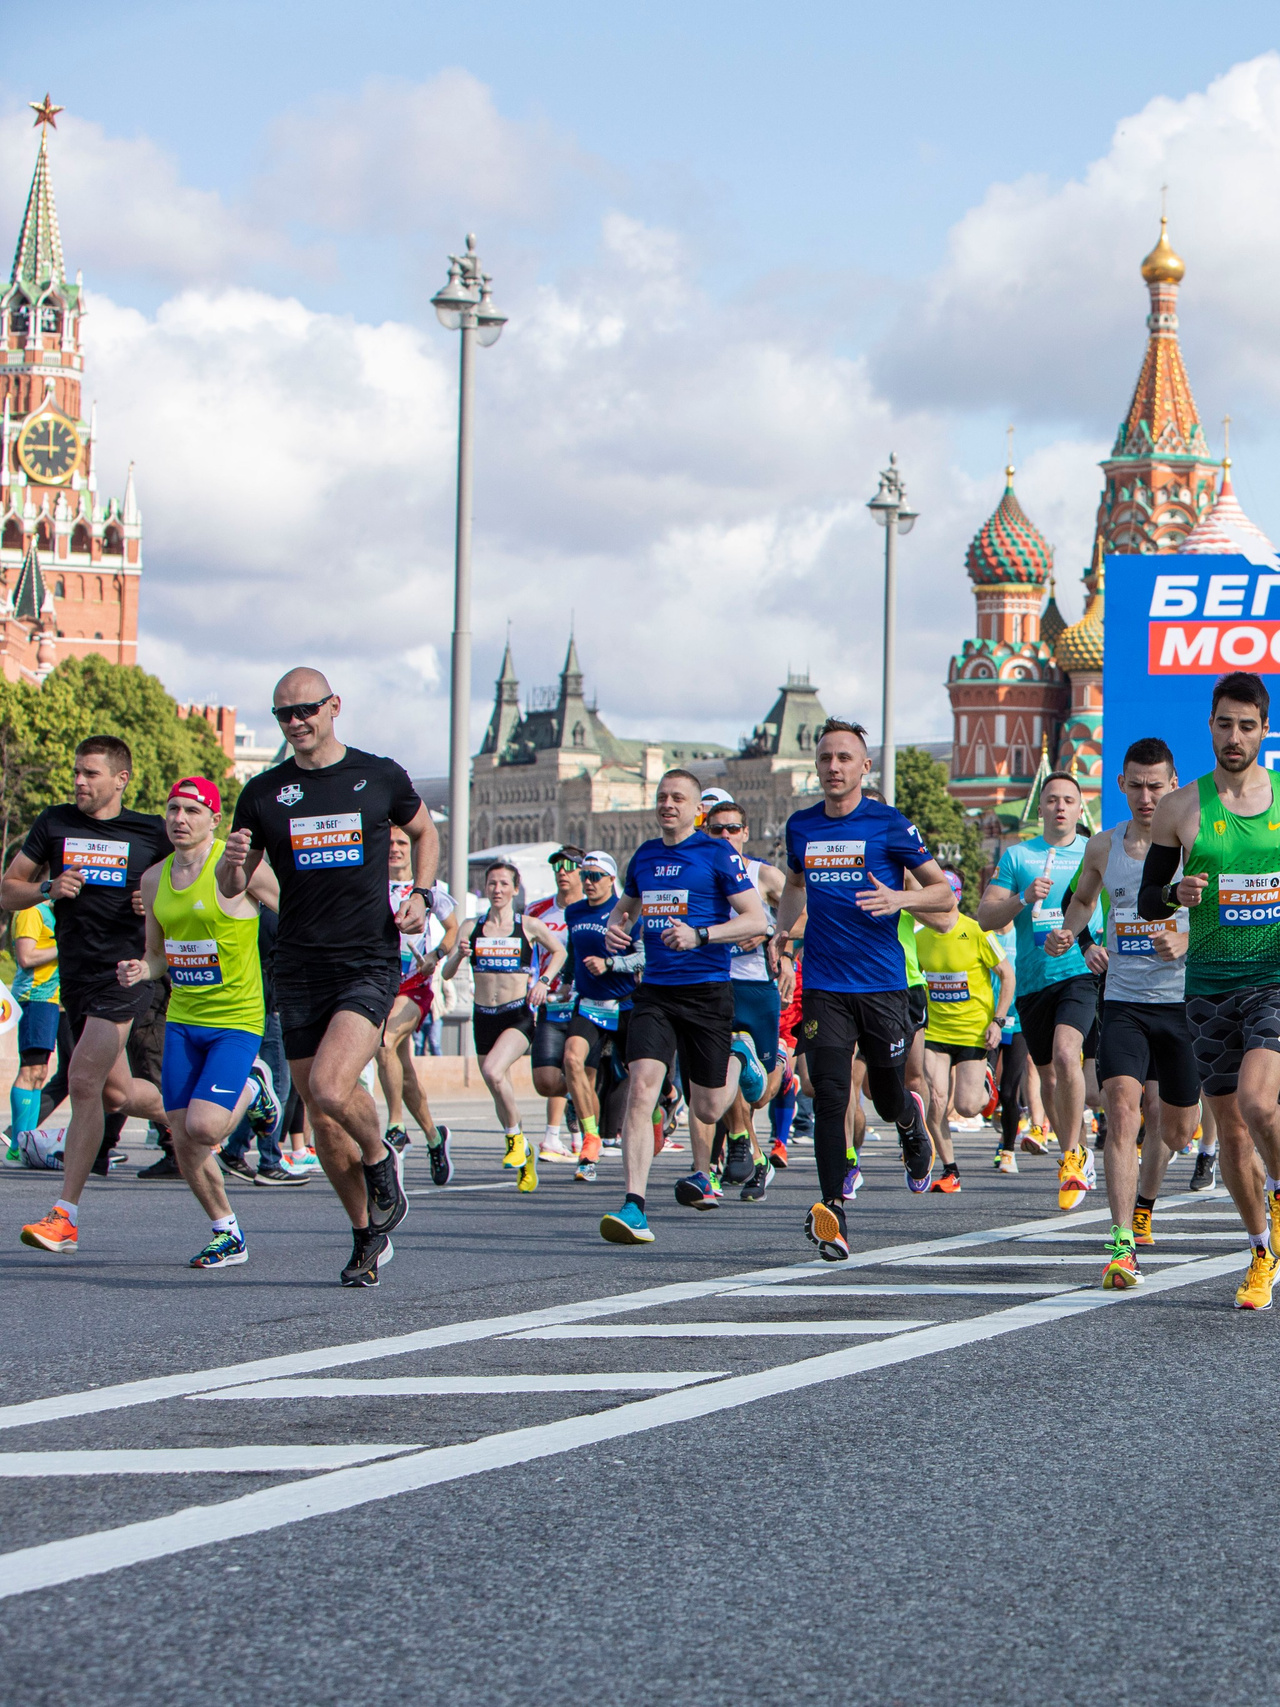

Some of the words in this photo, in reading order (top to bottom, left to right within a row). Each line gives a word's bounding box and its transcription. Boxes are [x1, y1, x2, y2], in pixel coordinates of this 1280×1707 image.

[299, 849, 360, 865] 02596
[79, 869, 123, 882] 2766
[809, 871, 863, 882] 02360
[648, 919, 682, 928] 0114
[1121, 940, 1154, 951] 223
[479, 959, 518, 967] 03592
[175, 970, 215, 981] 01143
[931, 991, 968, 1000] 00395
